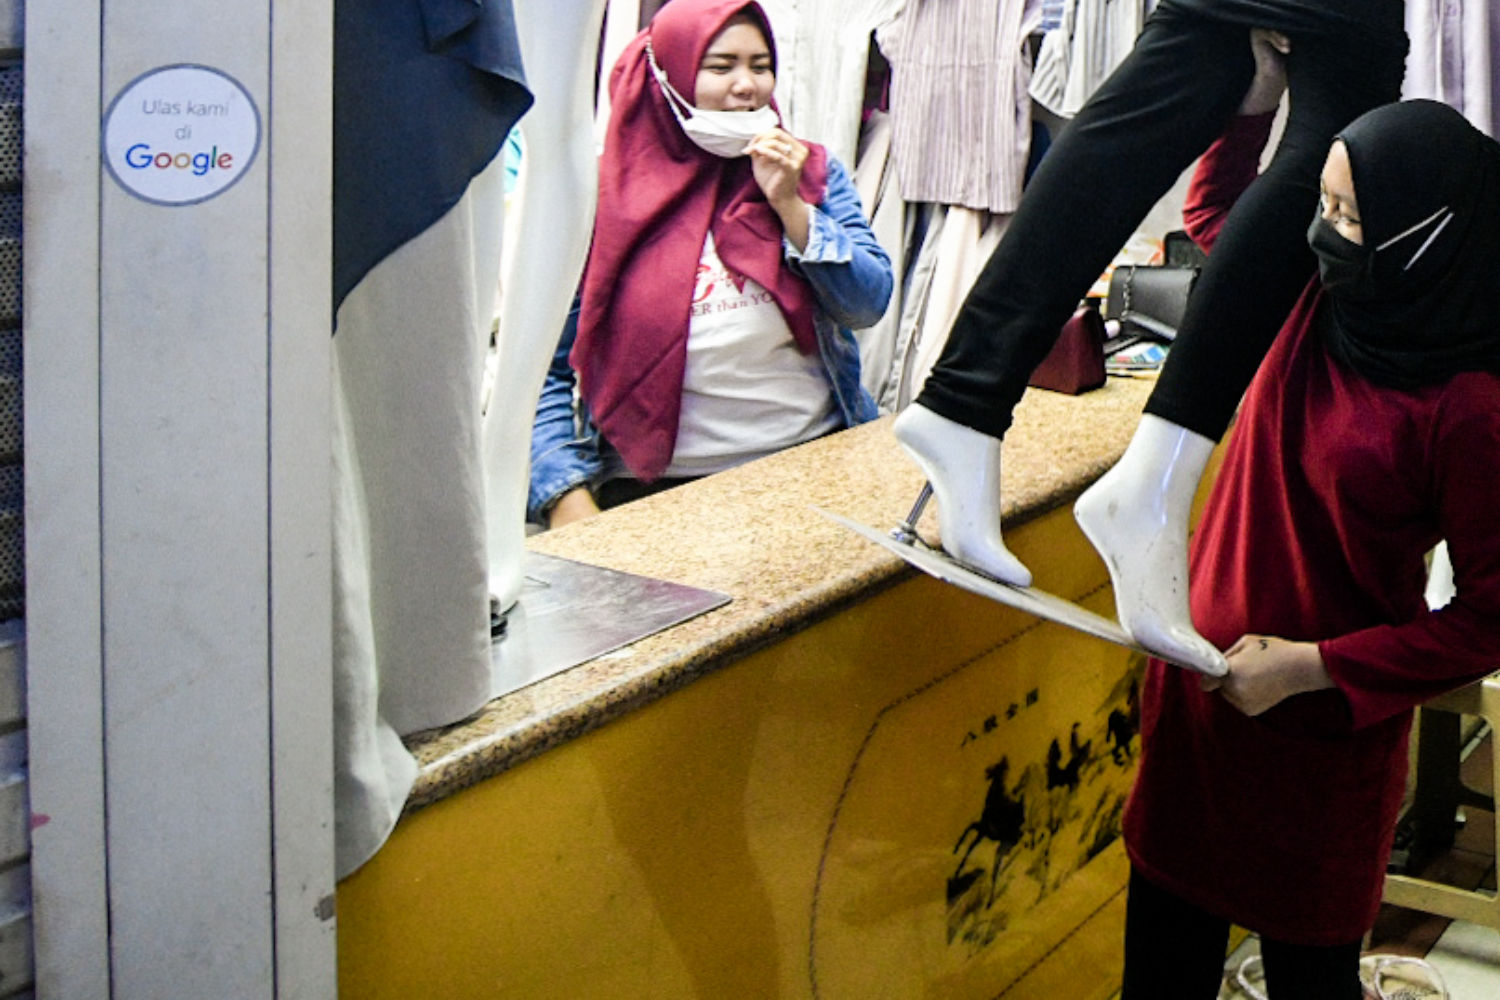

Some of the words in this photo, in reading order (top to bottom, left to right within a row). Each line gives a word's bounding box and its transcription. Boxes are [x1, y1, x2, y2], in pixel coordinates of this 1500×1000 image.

[142, 99, 181, 115] Ulas
[186, 99, 230, 117] kami
[174, 124, 193, 141] di
[125, 143, 233, 176] Google
[690, 302, 712, 317] ER
